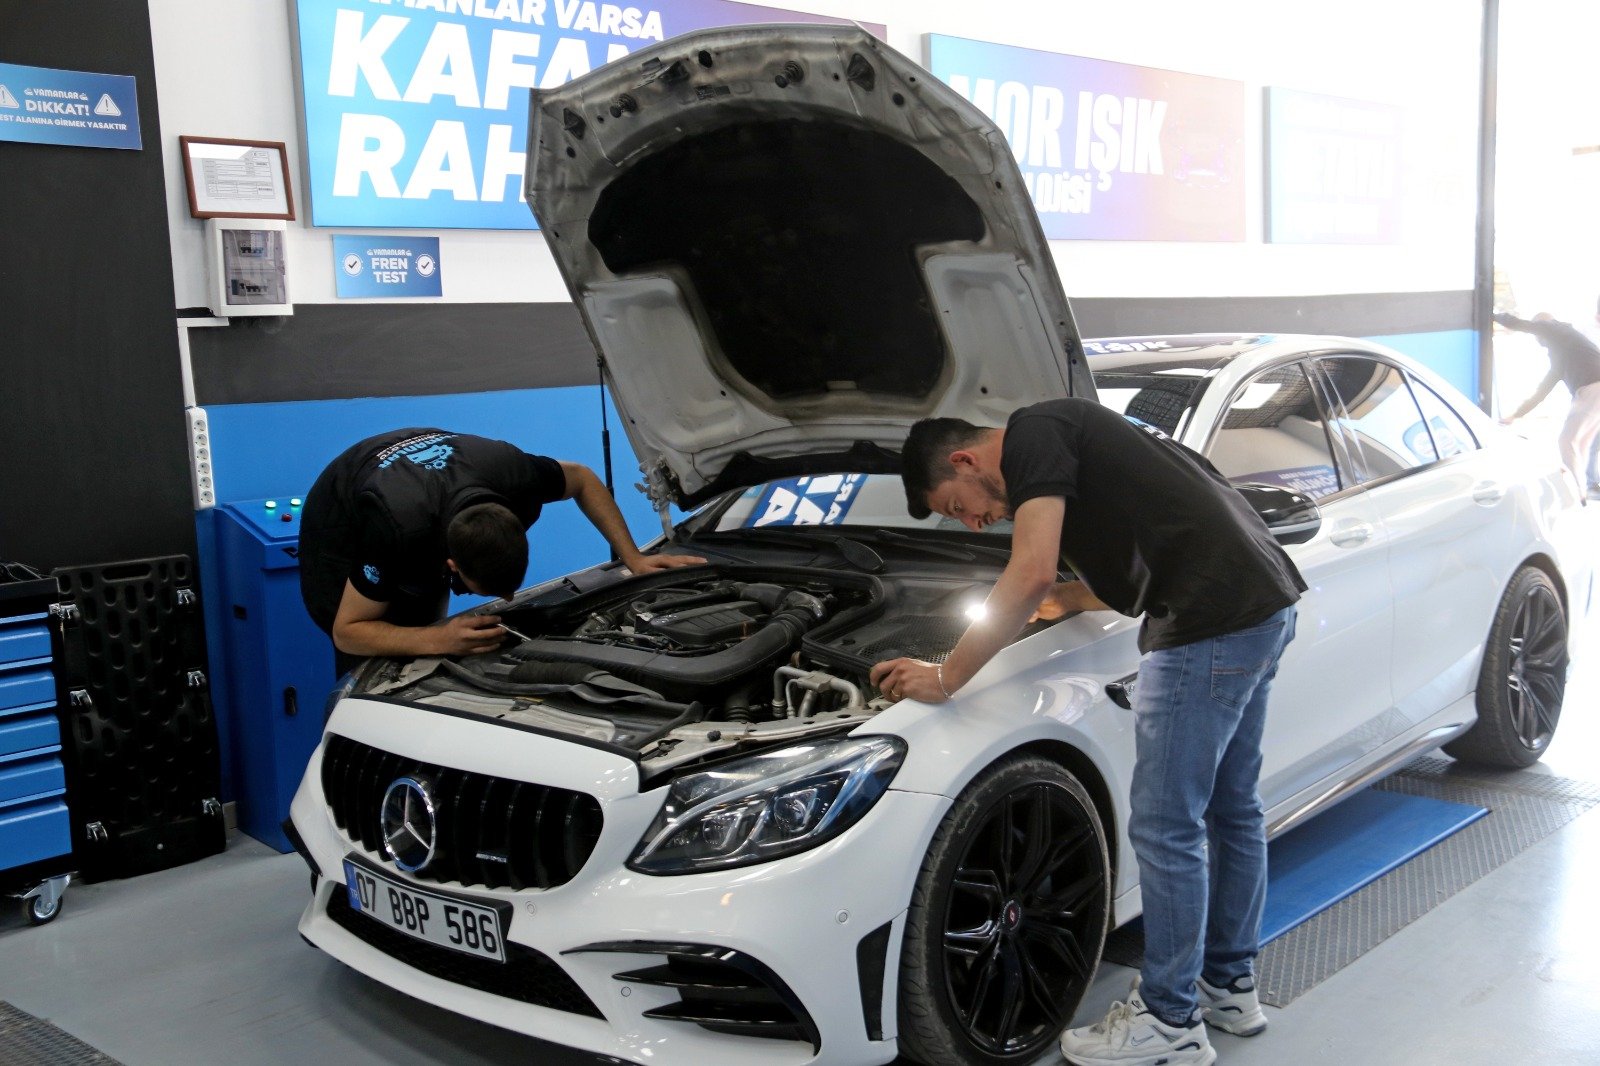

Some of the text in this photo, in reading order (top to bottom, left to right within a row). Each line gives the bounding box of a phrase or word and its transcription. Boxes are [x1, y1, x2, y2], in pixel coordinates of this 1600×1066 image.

[554, 0, 664, 41] VARSA
[328, 9, 630, 111] KAFA
[33, 88, 79, 100] YAMANLAR
[25, 99, 90, 116] DİKKAT!
[54, 118, 86, 128] GİRMEK
[87, 121, 127, 131] YASAKTIR
[1074, 90, 1168, 192] IŞIK
[371, 257, 408, 270] FREN
[373, 271, 408, 283] TEST
[355, 872, 497, 954] 07 BBP 586
